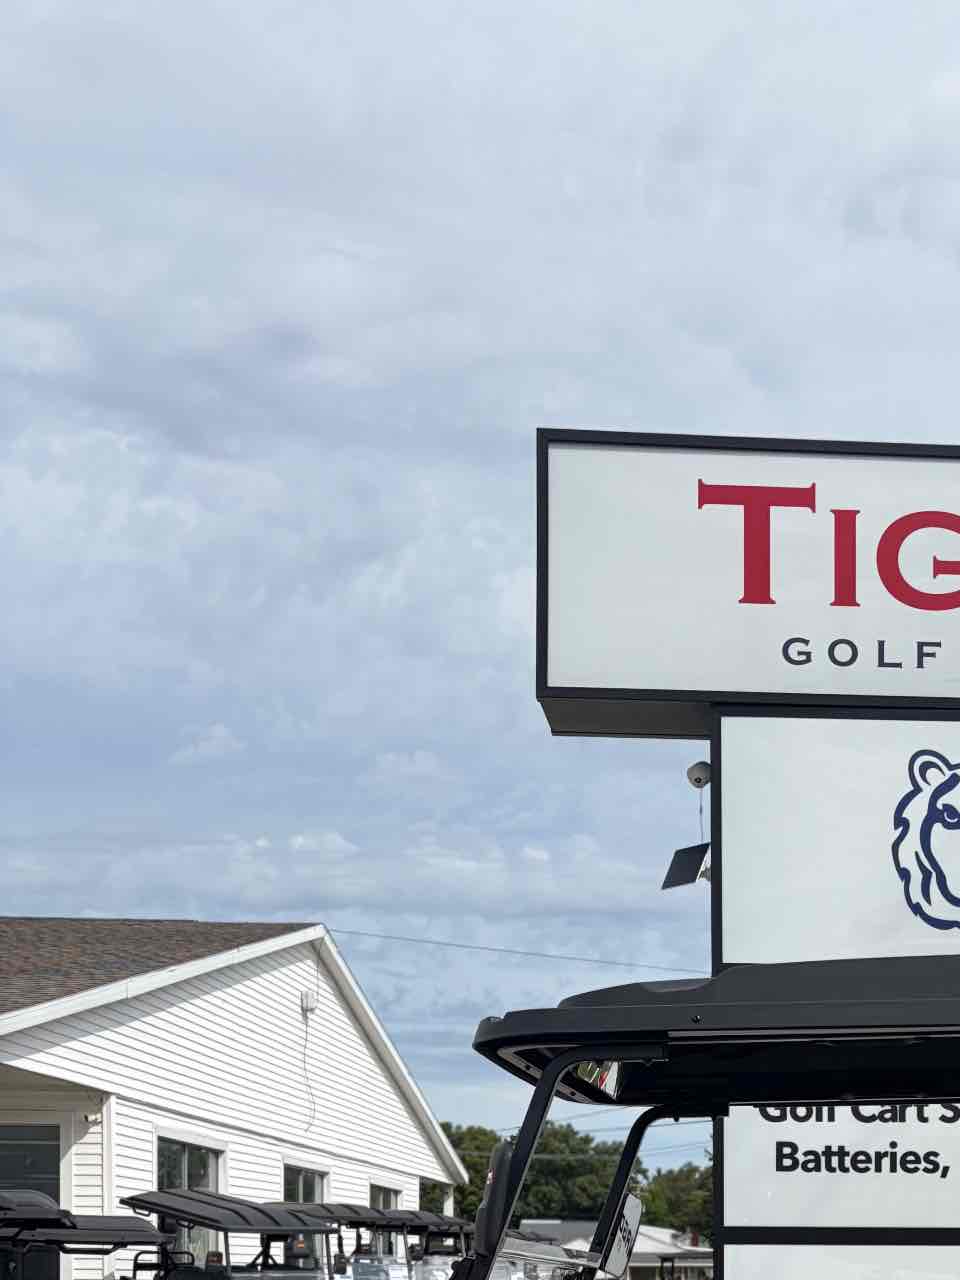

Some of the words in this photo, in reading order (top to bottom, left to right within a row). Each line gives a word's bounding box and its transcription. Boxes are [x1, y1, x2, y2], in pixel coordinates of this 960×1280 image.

[781, 637, 942, 669] GOLF
[850, 1104, 929, 1124] Cart
[775, 1140, 950, 1179] Batteries,
